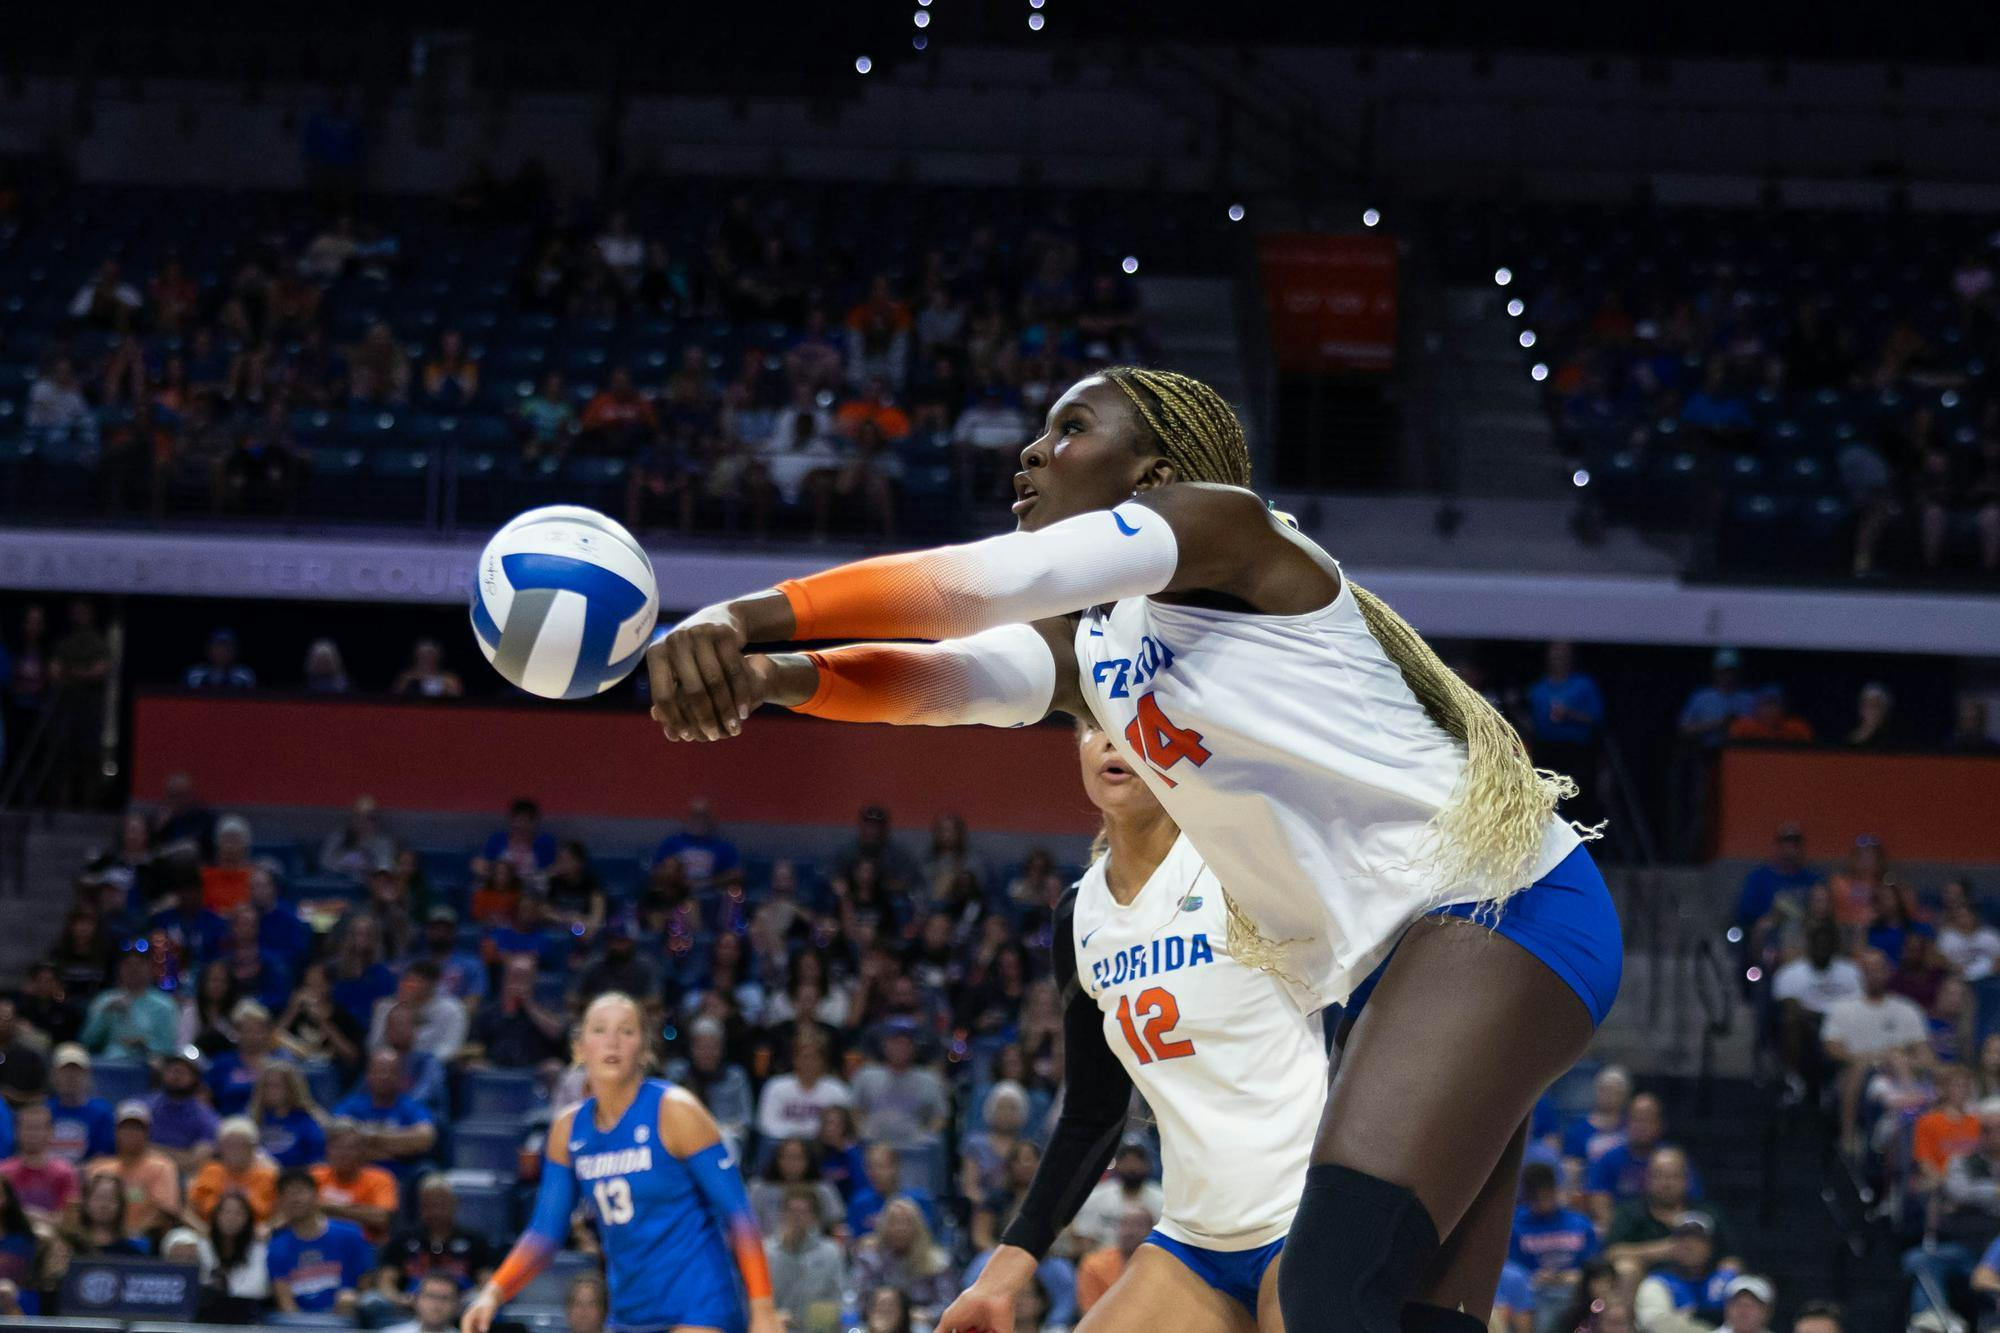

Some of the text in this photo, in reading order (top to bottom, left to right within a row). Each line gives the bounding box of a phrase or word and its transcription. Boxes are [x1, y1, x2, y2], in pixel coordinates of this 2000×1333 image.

[348, 563, 476, 595] COUR
[1125, 691, 1213, 789] 14
[1091, 934, 1214, 992] FLORIDA
[1116, 986, 1196, 1065] 12
[593, 1176, 635, 1226] 13
